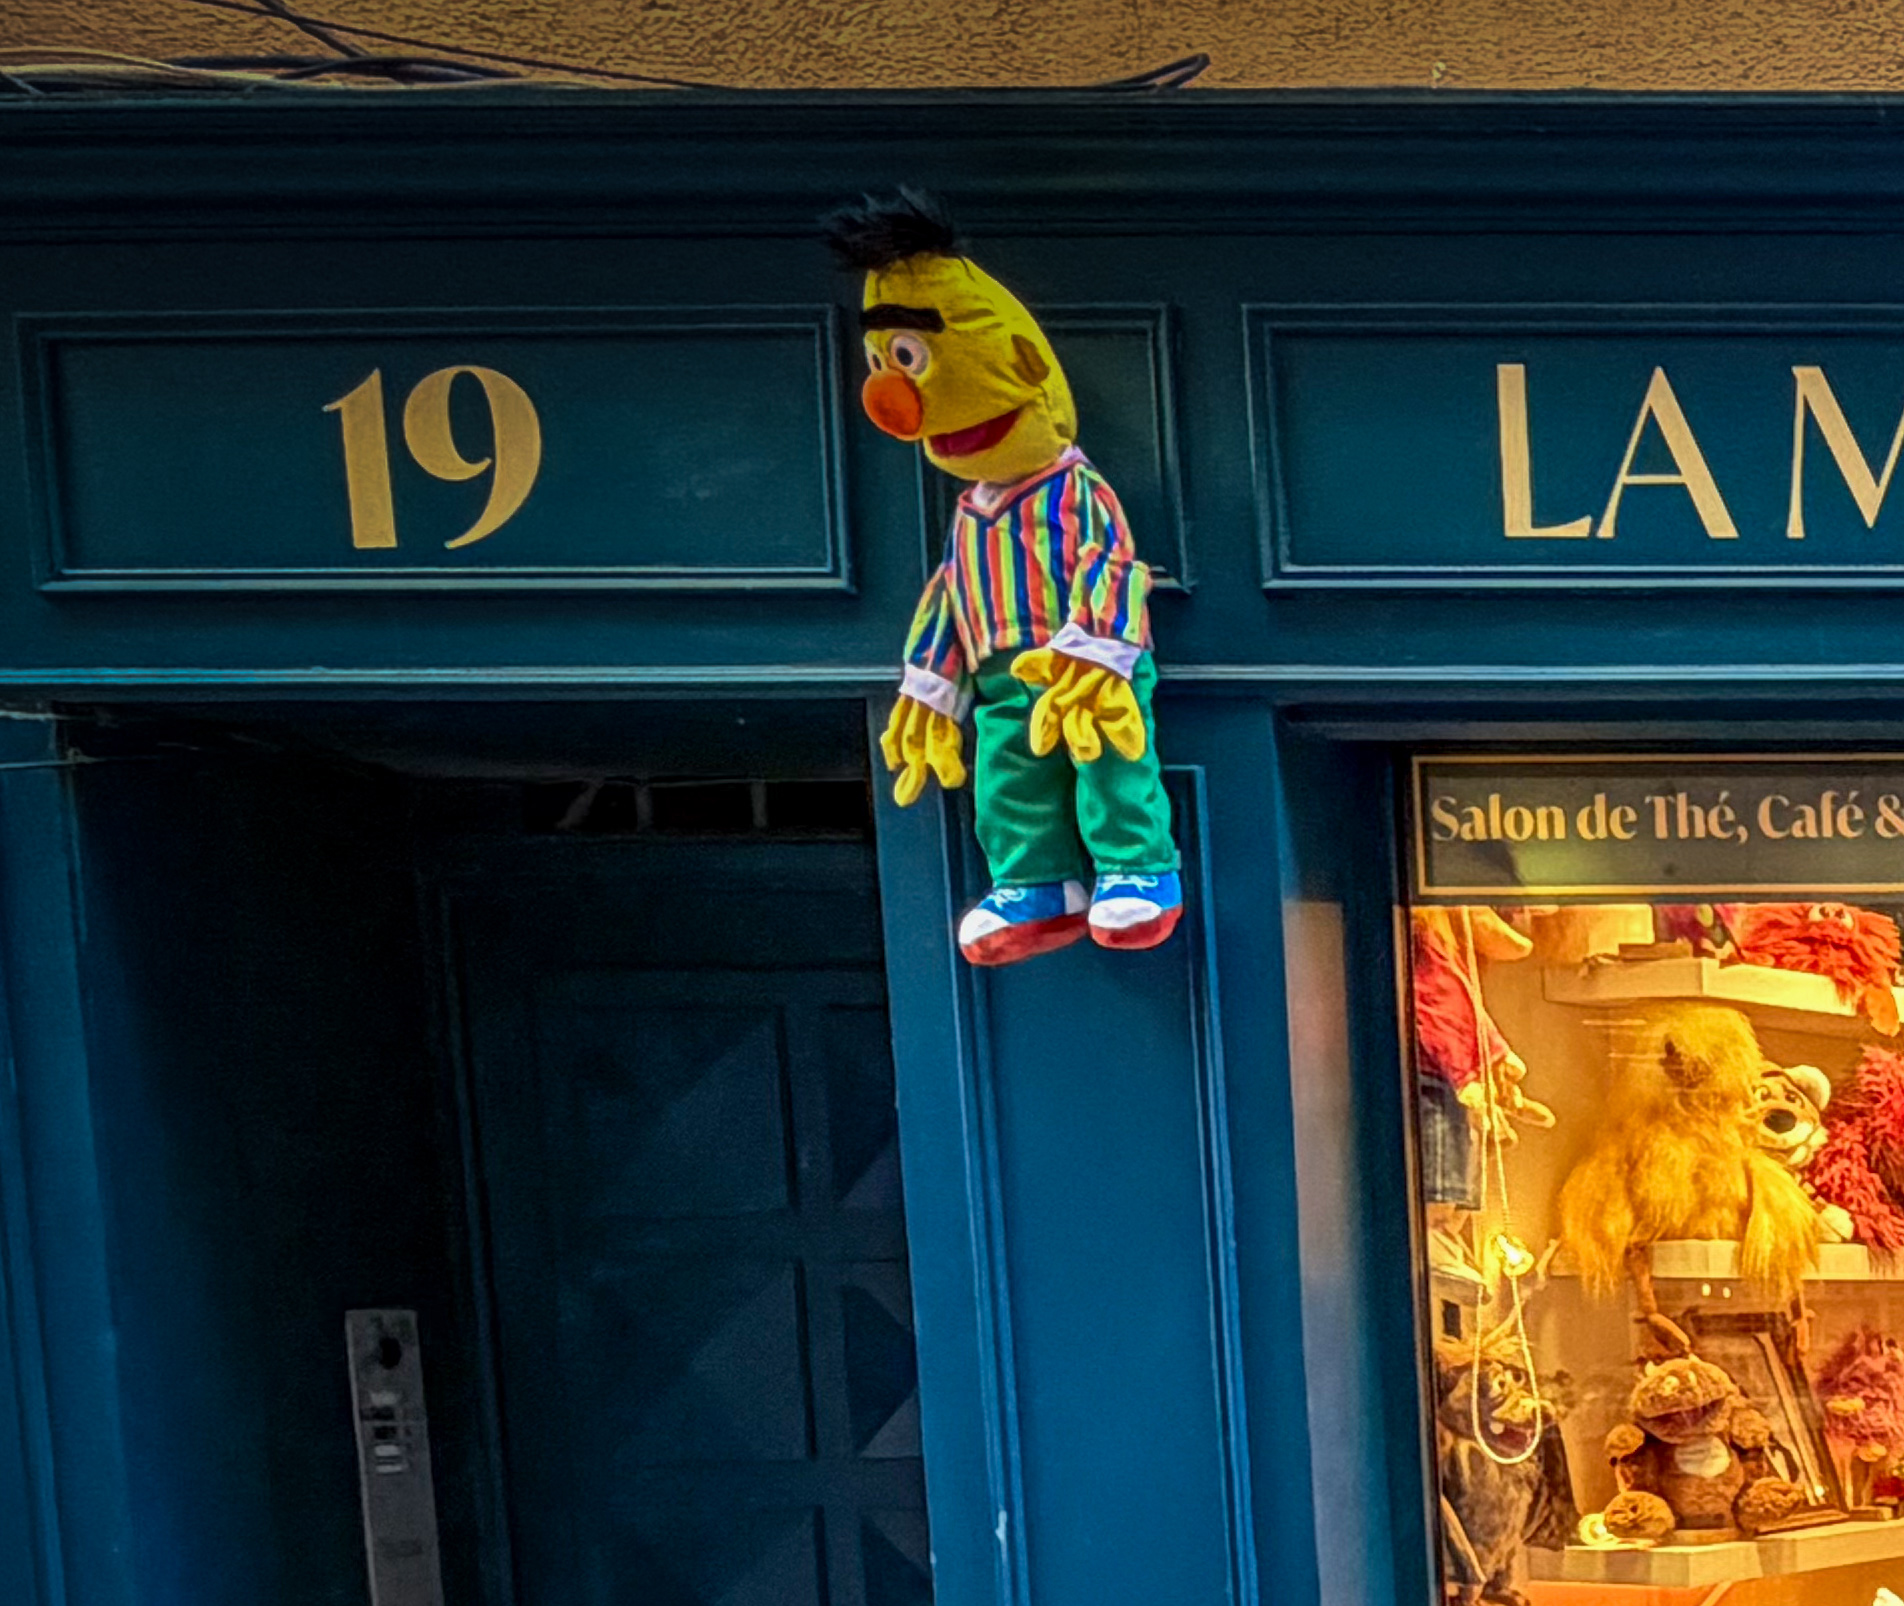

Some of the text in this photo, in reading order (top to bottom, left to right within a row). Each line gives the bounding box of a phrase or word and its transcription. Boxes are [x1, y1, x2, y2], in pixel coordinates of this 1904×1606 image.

[323, 364, 542, 549] 19
[1497, 363, 1739, 539] LA
[1432, 792, 1566, 842] Salon
[1576, 792, 1637, 840] de
[1645, 791, 1748, 845] Thé,
[1757, 790, 1864, 839] Café
